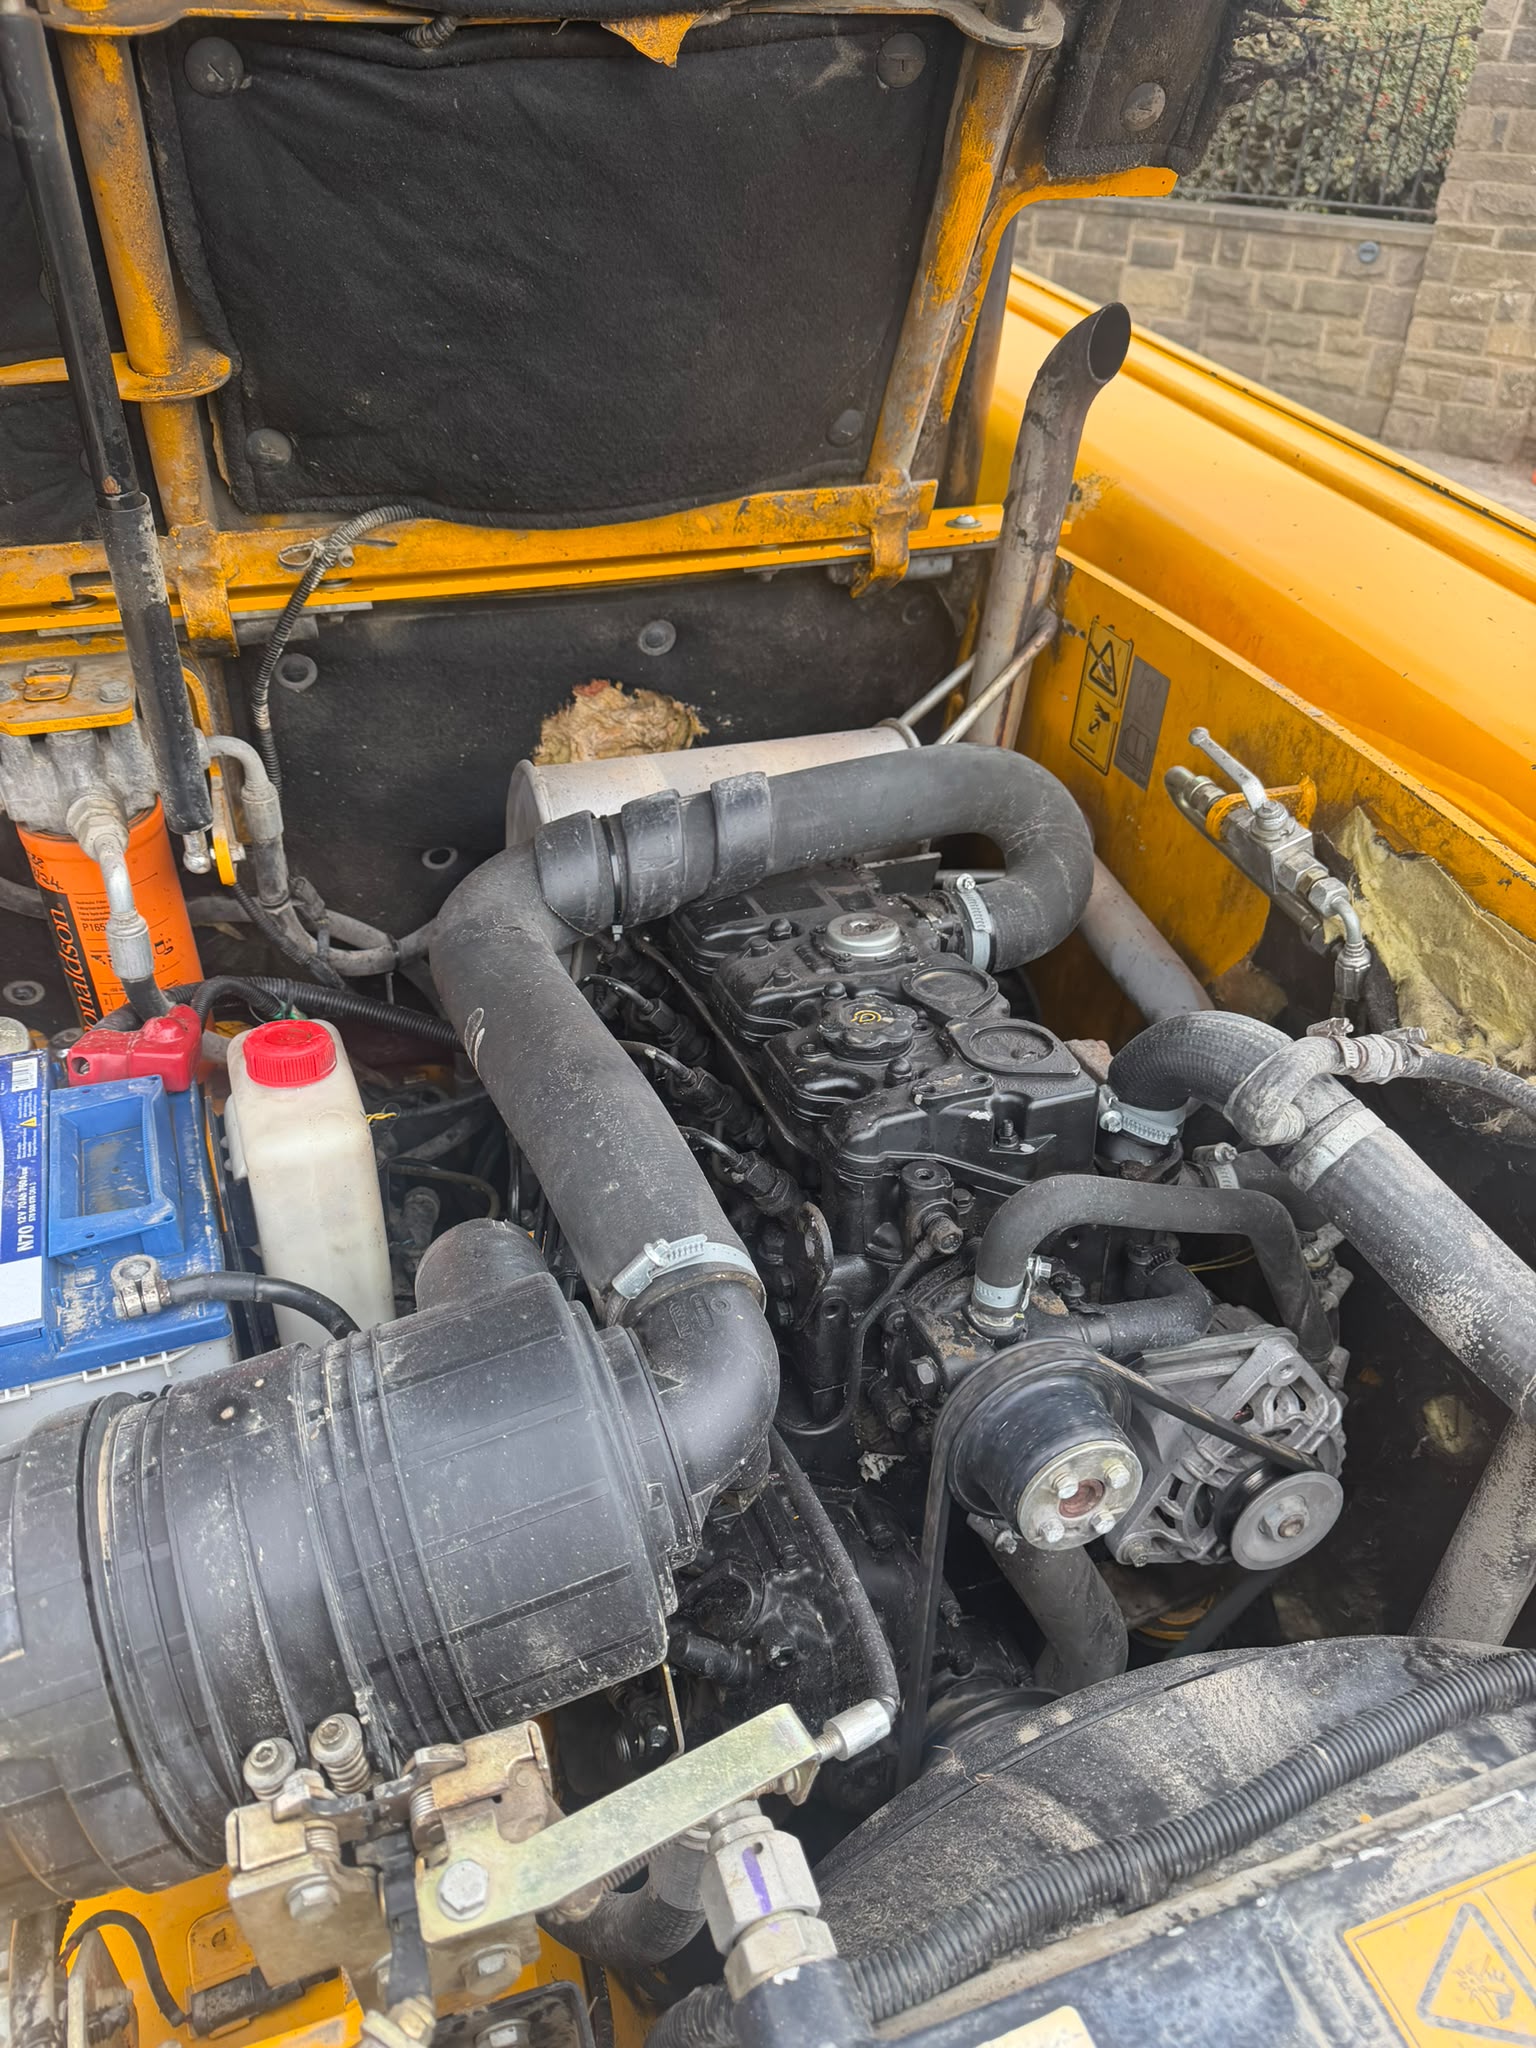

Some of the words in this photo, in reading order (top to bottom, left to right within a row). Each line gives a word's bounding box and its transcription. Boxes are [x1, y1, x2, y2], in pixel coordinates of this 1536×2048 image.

[82, 922, 107, 932] P165
[50, 906, 99, 1032] onaldson
[17, 1211, 27, 1225] 12V
[16, 1225, 35, 1252] N70
